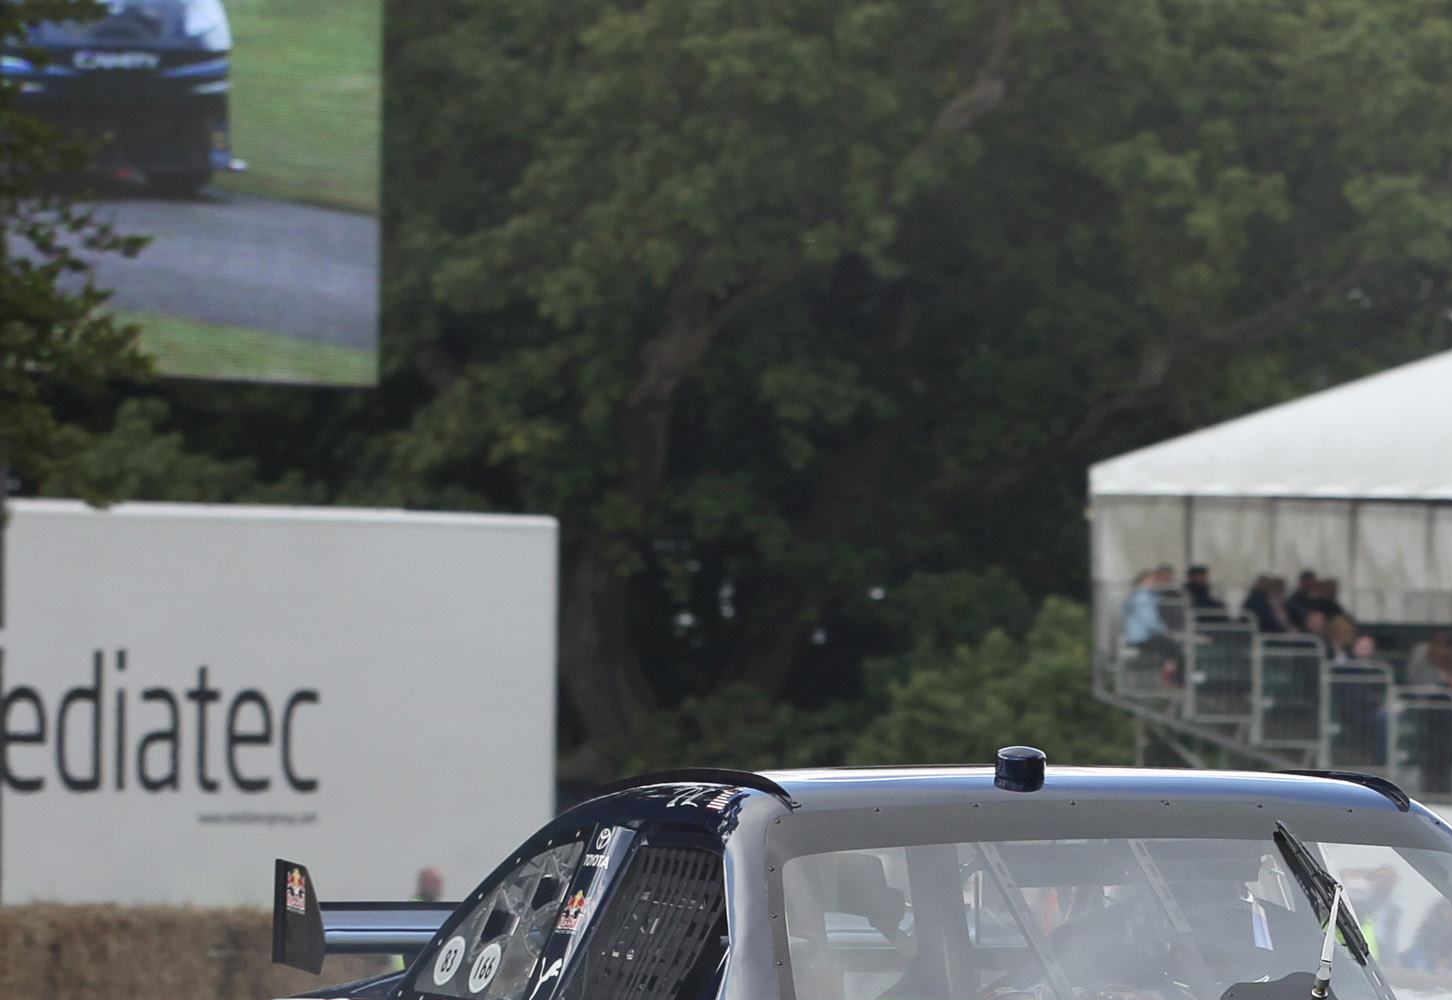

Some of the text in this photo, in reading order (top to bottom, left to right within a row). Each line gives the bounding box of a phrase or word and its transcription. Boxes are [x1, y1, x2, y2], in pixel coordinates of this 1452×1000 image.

[583, 853, 610, 870] TOYOTA
[440, 948, 458, 973] 83
[473, 956, 496, 980] 166
